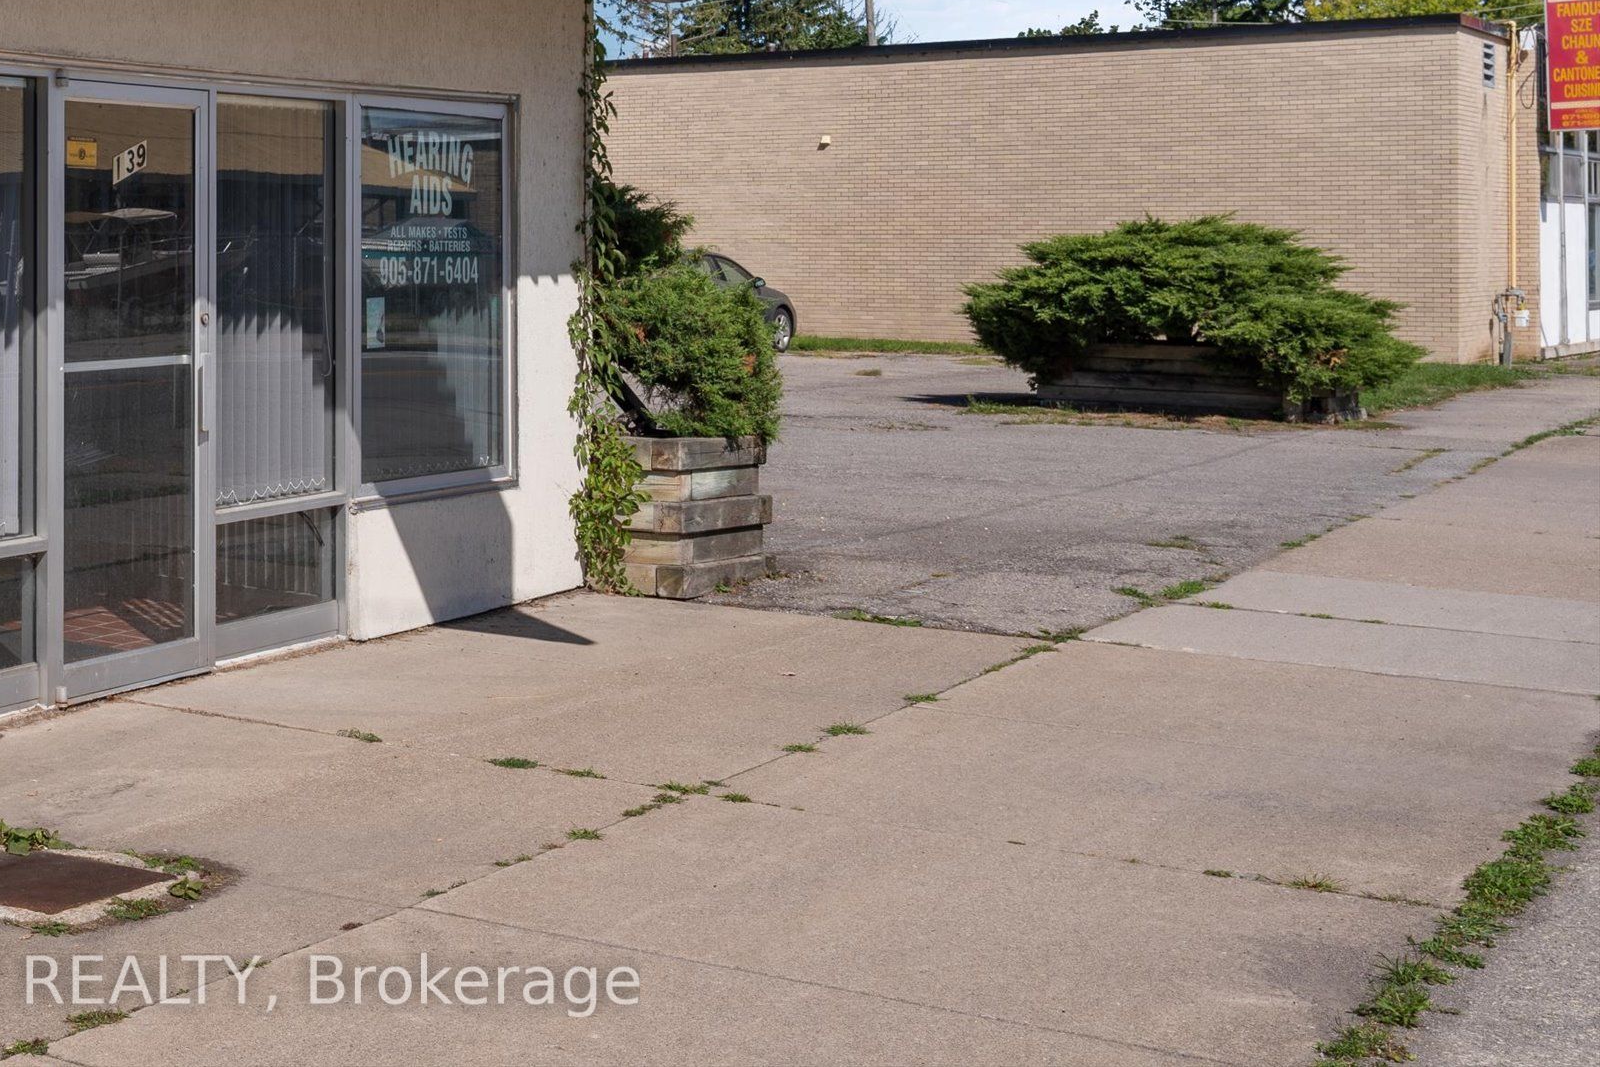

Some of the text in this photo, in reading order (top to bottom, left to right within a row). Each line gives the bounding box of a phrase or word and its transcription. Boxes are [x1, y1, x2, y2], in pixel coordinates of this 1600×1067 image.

[1570, 18, 1593, 33] SZE
[1575, 49, 1589, 64] &
[116, 143, 147, 180] 139
[387, 130, 474, 190] HEARING
[409, 174, 453, 216] AIDS
[390, 225, 468, 239] ALL MAKES TESTS
[429, 240, 471, 252] BATTERIES
[380, 256, 479, 285] 905-871-6404
